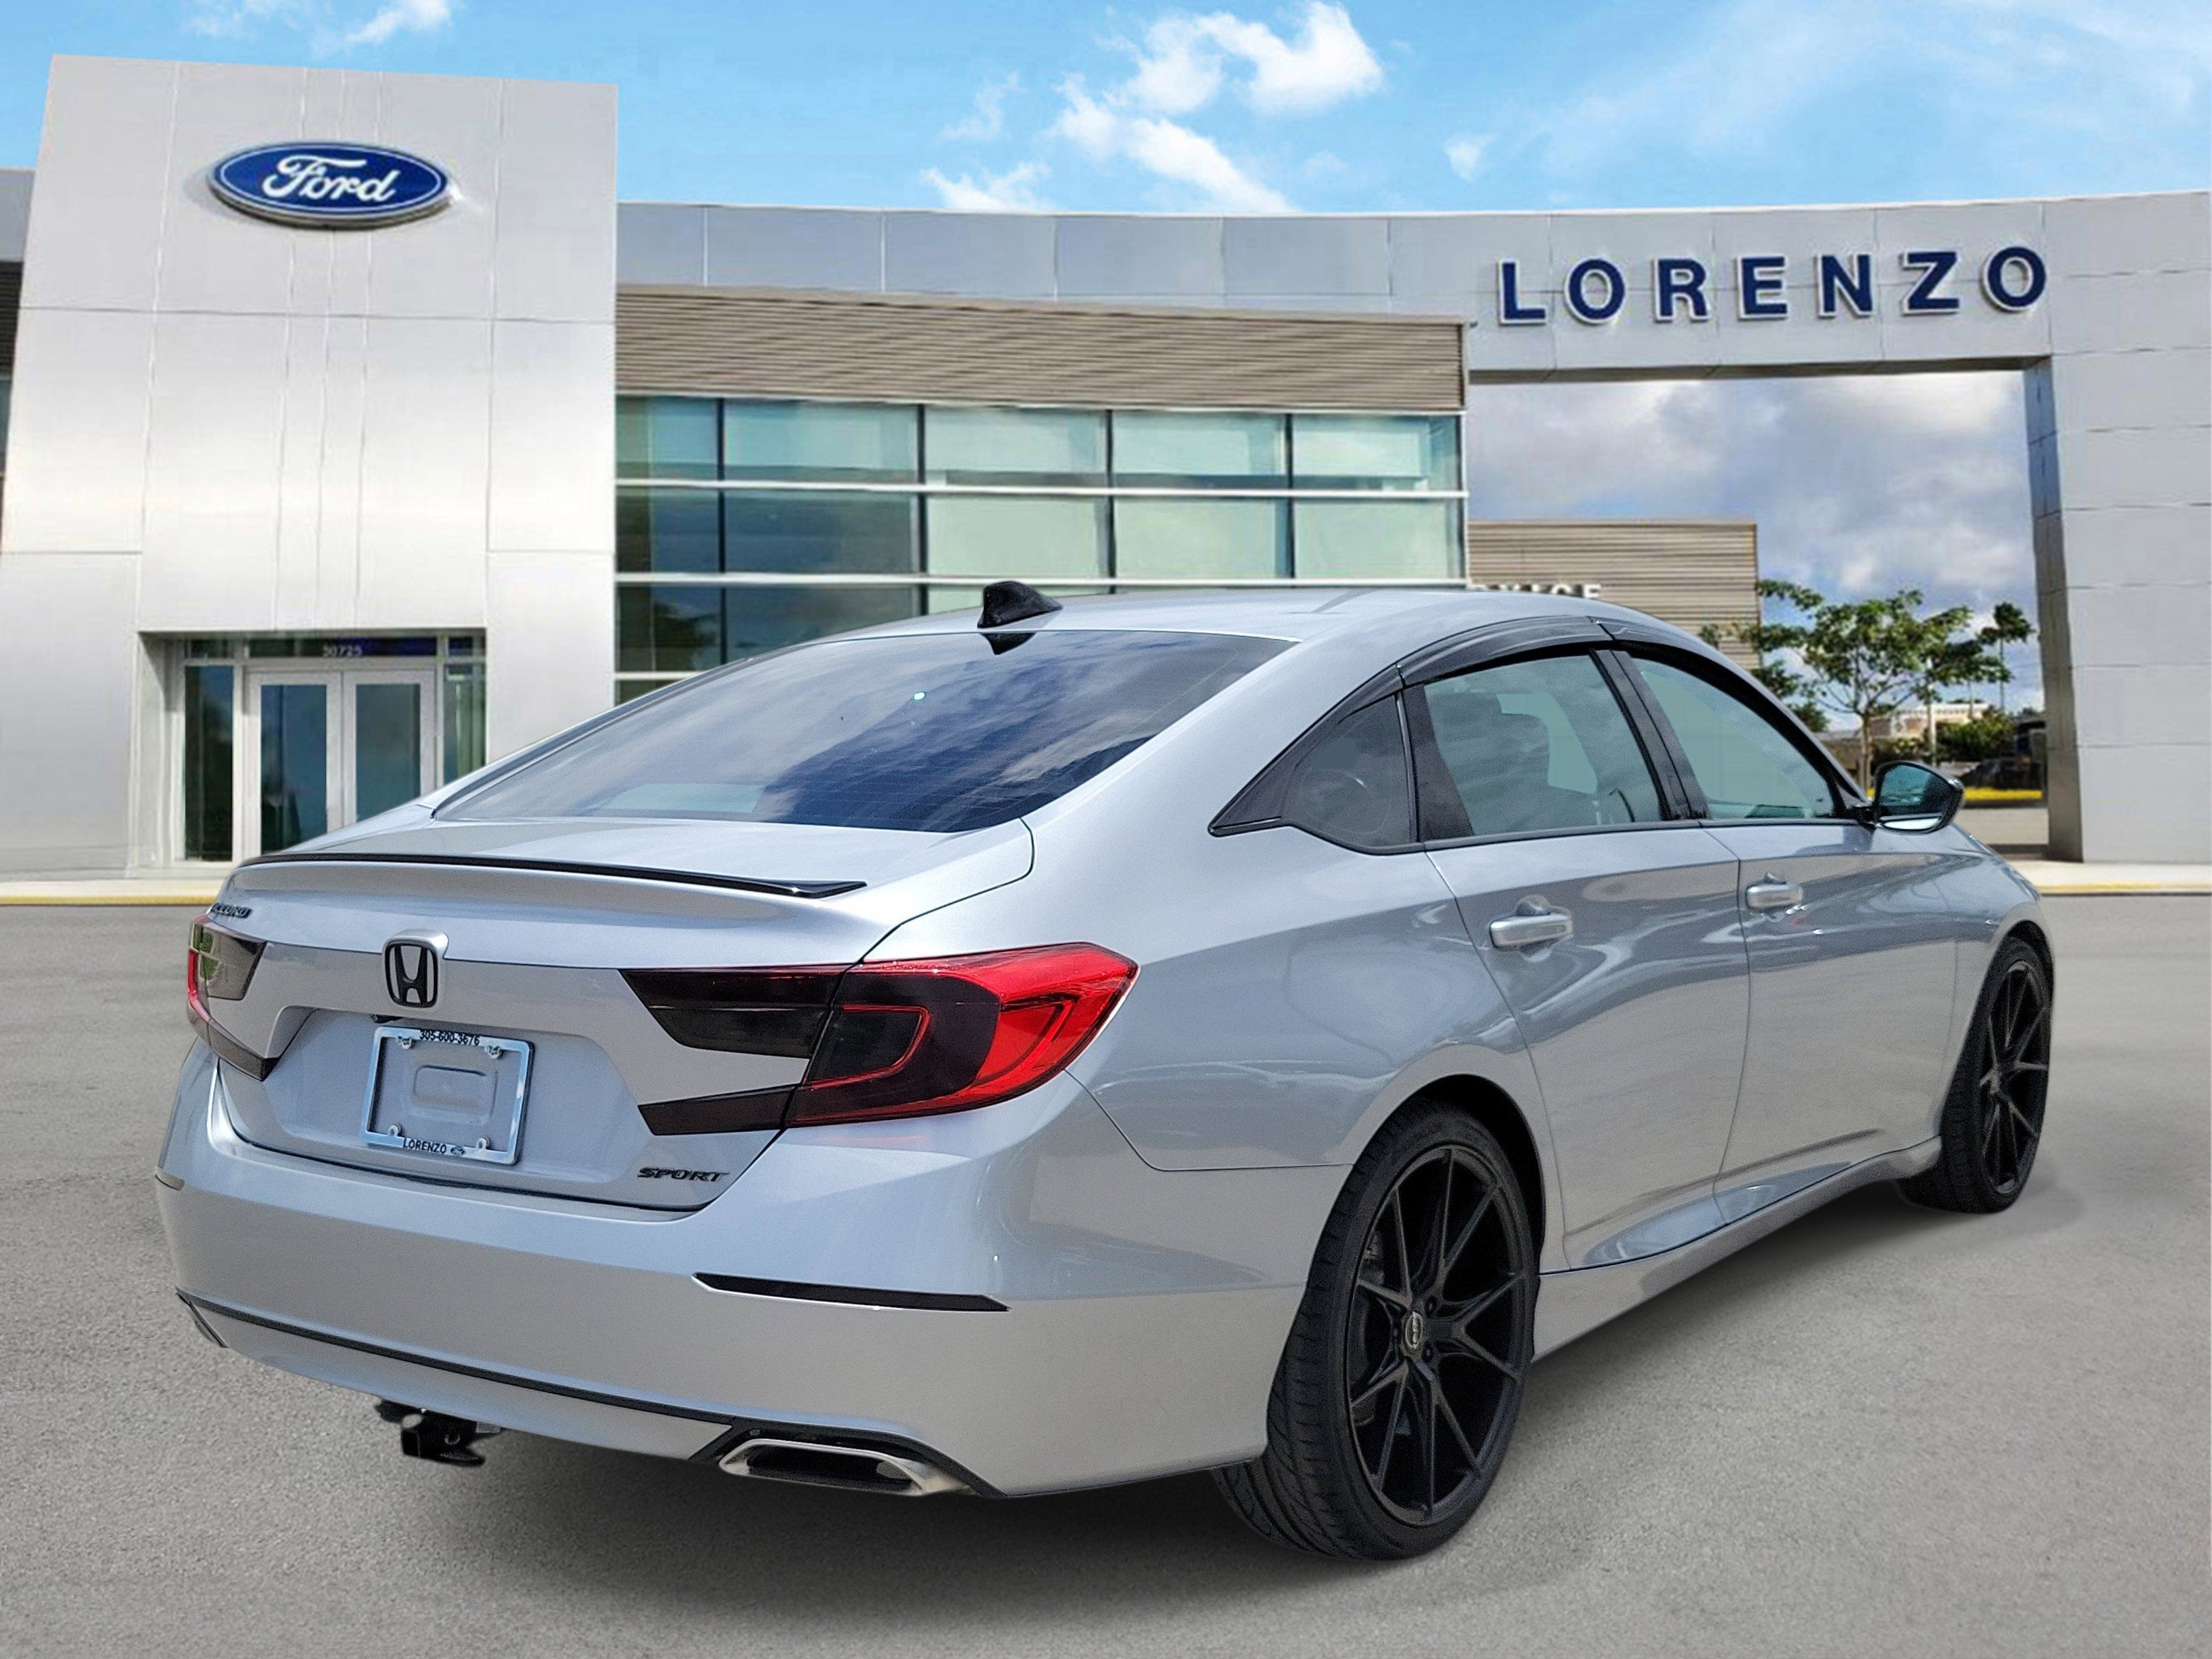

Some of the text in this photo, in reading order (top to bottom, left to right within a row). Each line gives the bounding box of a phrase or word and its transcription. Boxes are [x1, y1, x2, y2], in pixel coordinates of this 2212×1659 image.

[262, 155, 400, 202] Ford
[1500, 246, 2047, 324] LORENZO
[403, 1137, 446, 1154] LORENZO
[637, 1167, 730, 1182] SPORT
